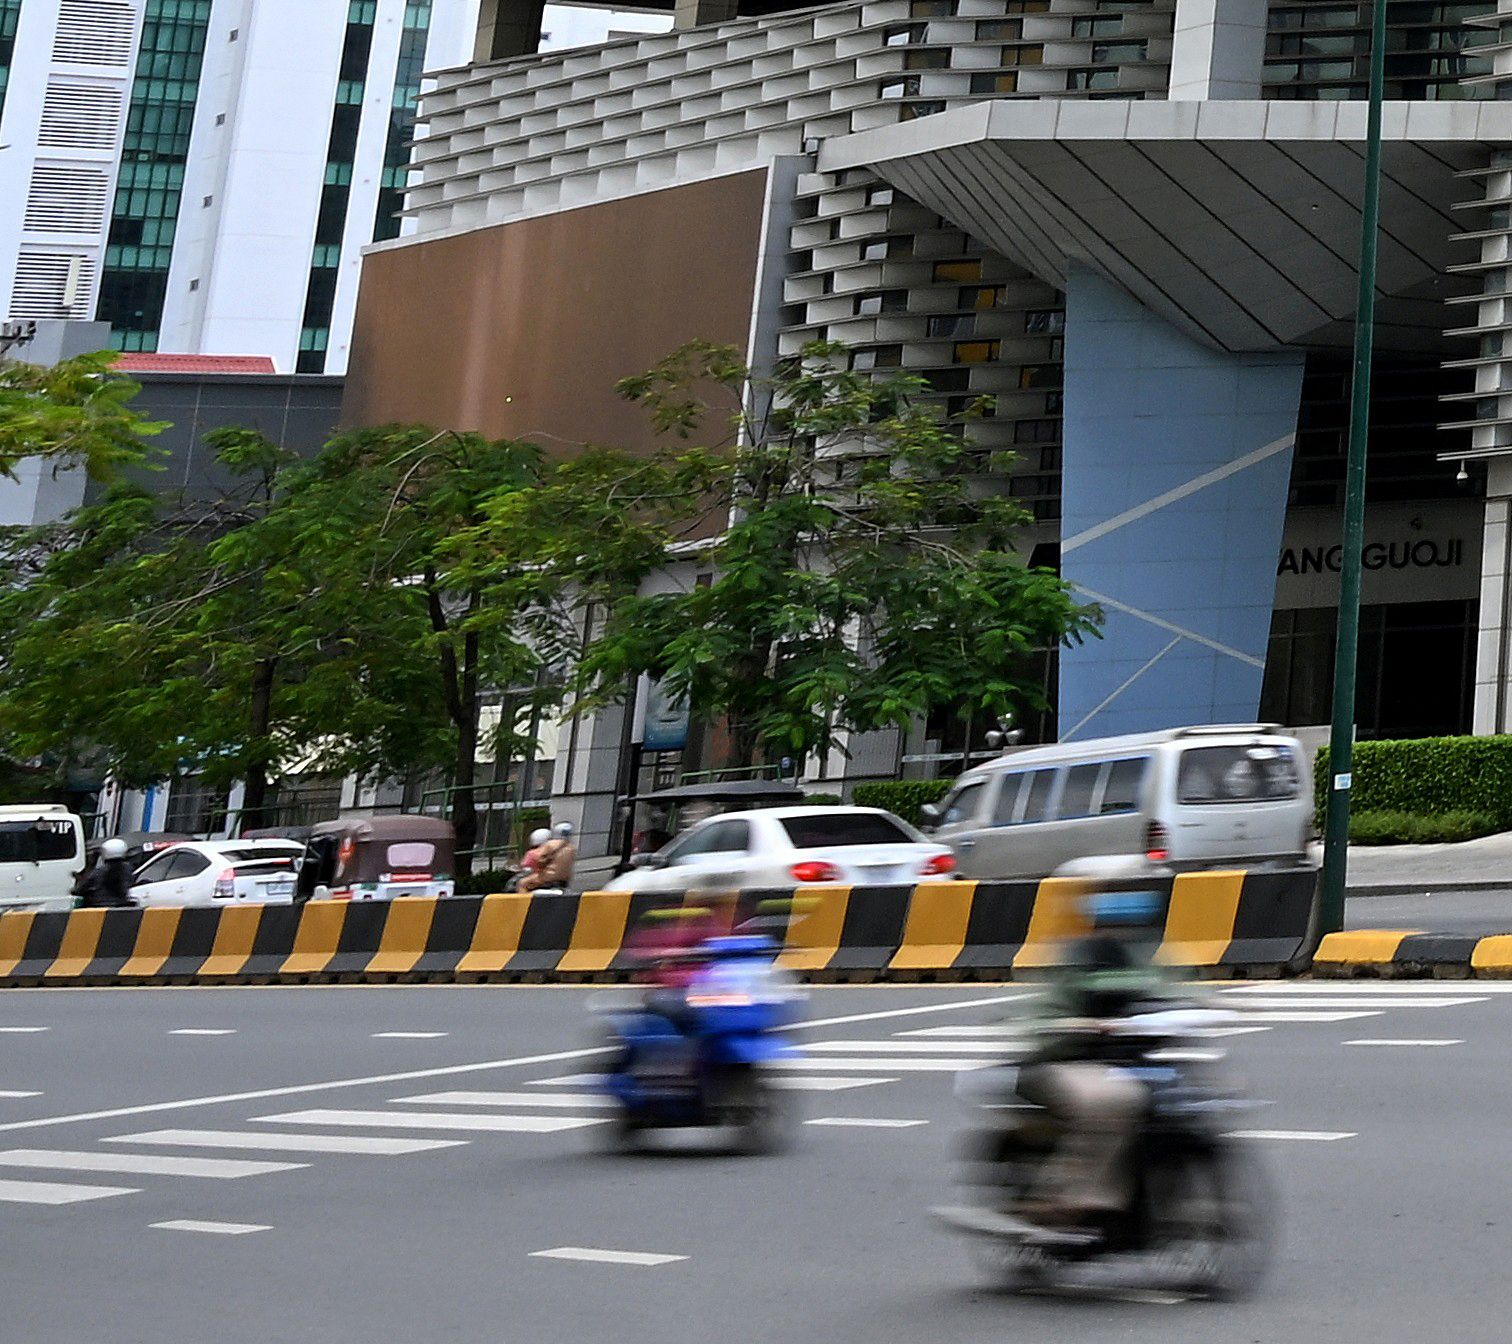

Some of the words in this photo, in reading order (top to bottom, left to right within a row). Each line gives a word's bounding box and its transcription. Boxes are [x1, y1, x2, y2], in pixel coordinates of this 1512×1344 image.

[1277, 543, 1343, 576] ANG
[1361, 538, 1462, 571] GUOJI
[49, 820, 73, 835] VIP
